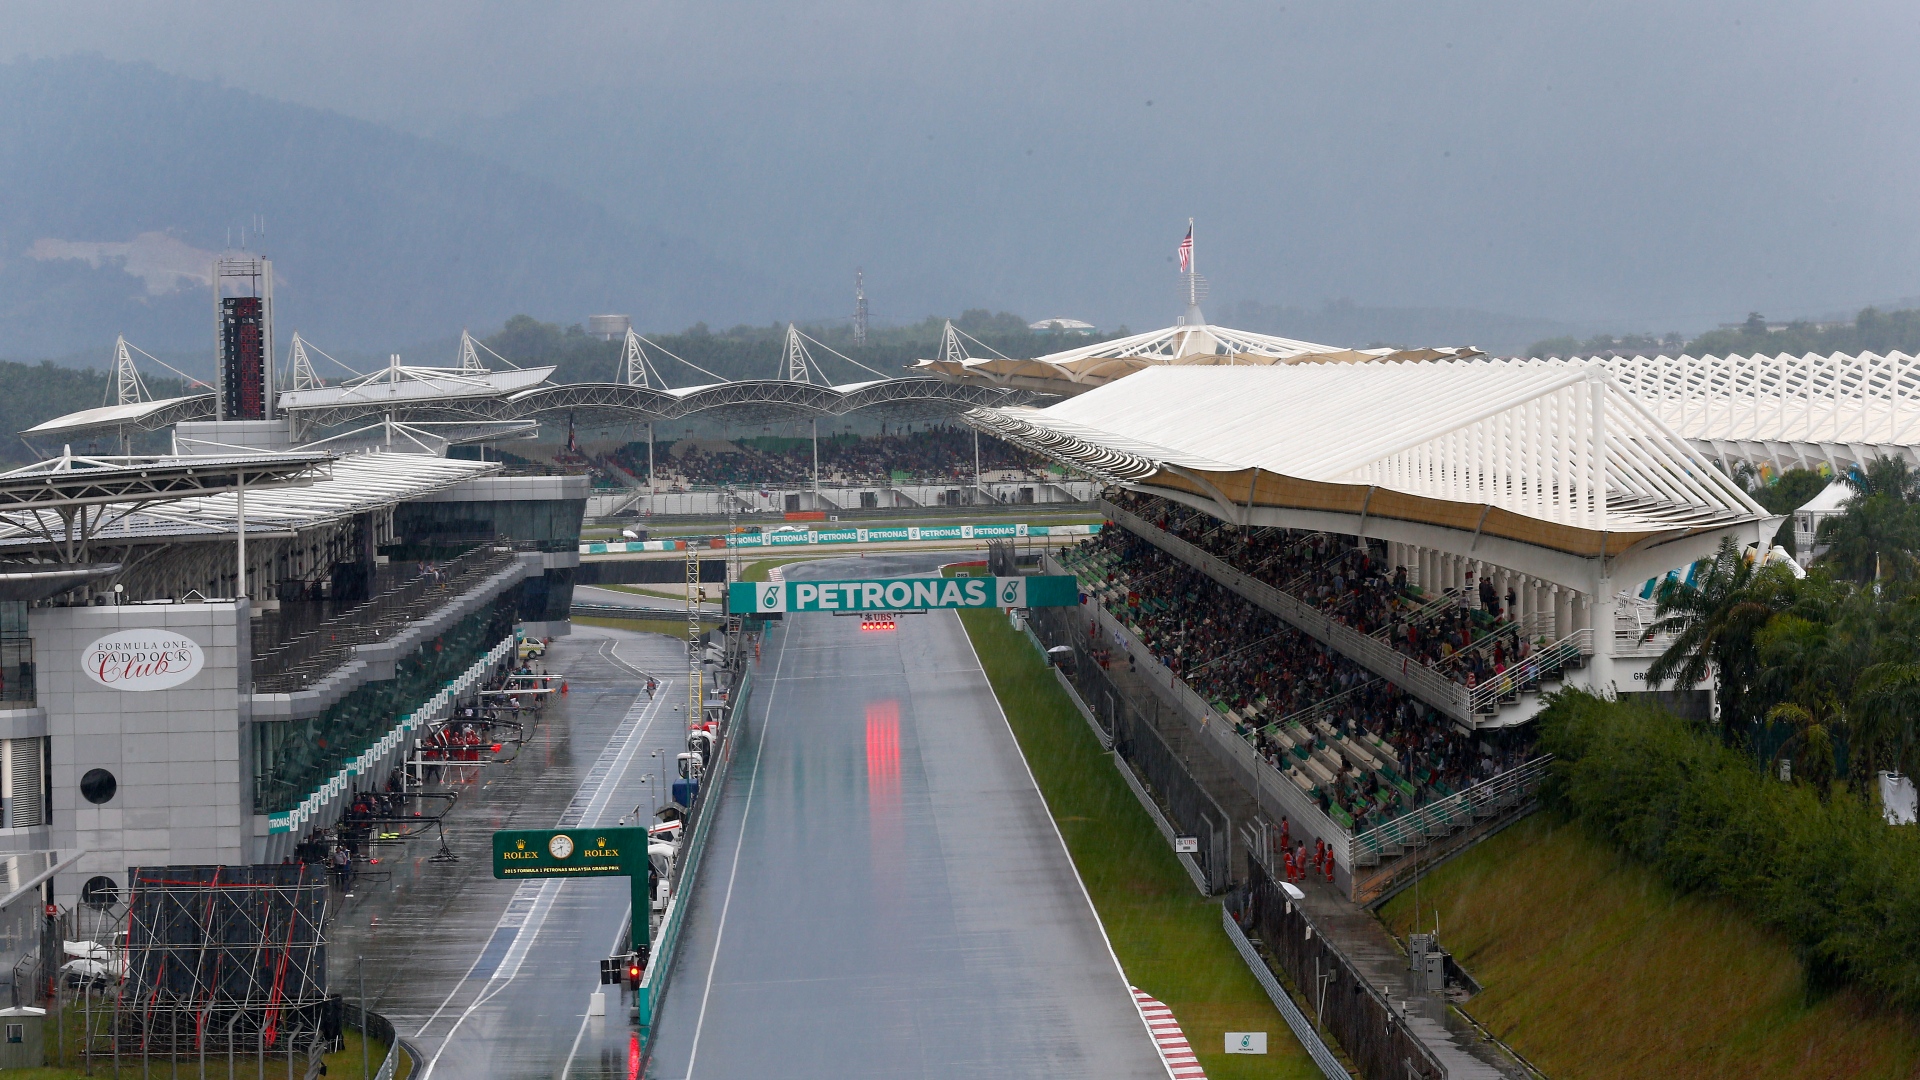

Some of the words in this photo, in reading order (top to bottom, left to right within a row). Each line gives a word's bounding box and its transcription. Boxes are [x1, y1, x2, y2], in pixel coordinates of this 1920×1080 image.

[869, 530, 907, 539] PETRONAS
[921, 529, 960, 537] PETRONAS
[974, 527, 1015, 535] PETRONAS
[772, 534, 807, 542] PETRONAS
[819, 532, 856, 540] PETRONAS
[796, 580, 987, 610] PETRONAS
[873, 613, 892, 621] UBS
[98, 642, 158, 650] FORMULA
[163, 641, 187, 649] ONE
[98, 651, 187, 663] PADDOCK
[88, 649, 192, 683] Club
[1633, 672, 1682, 680] GRAAND
[584, 849, 619, 857] ROLEX
